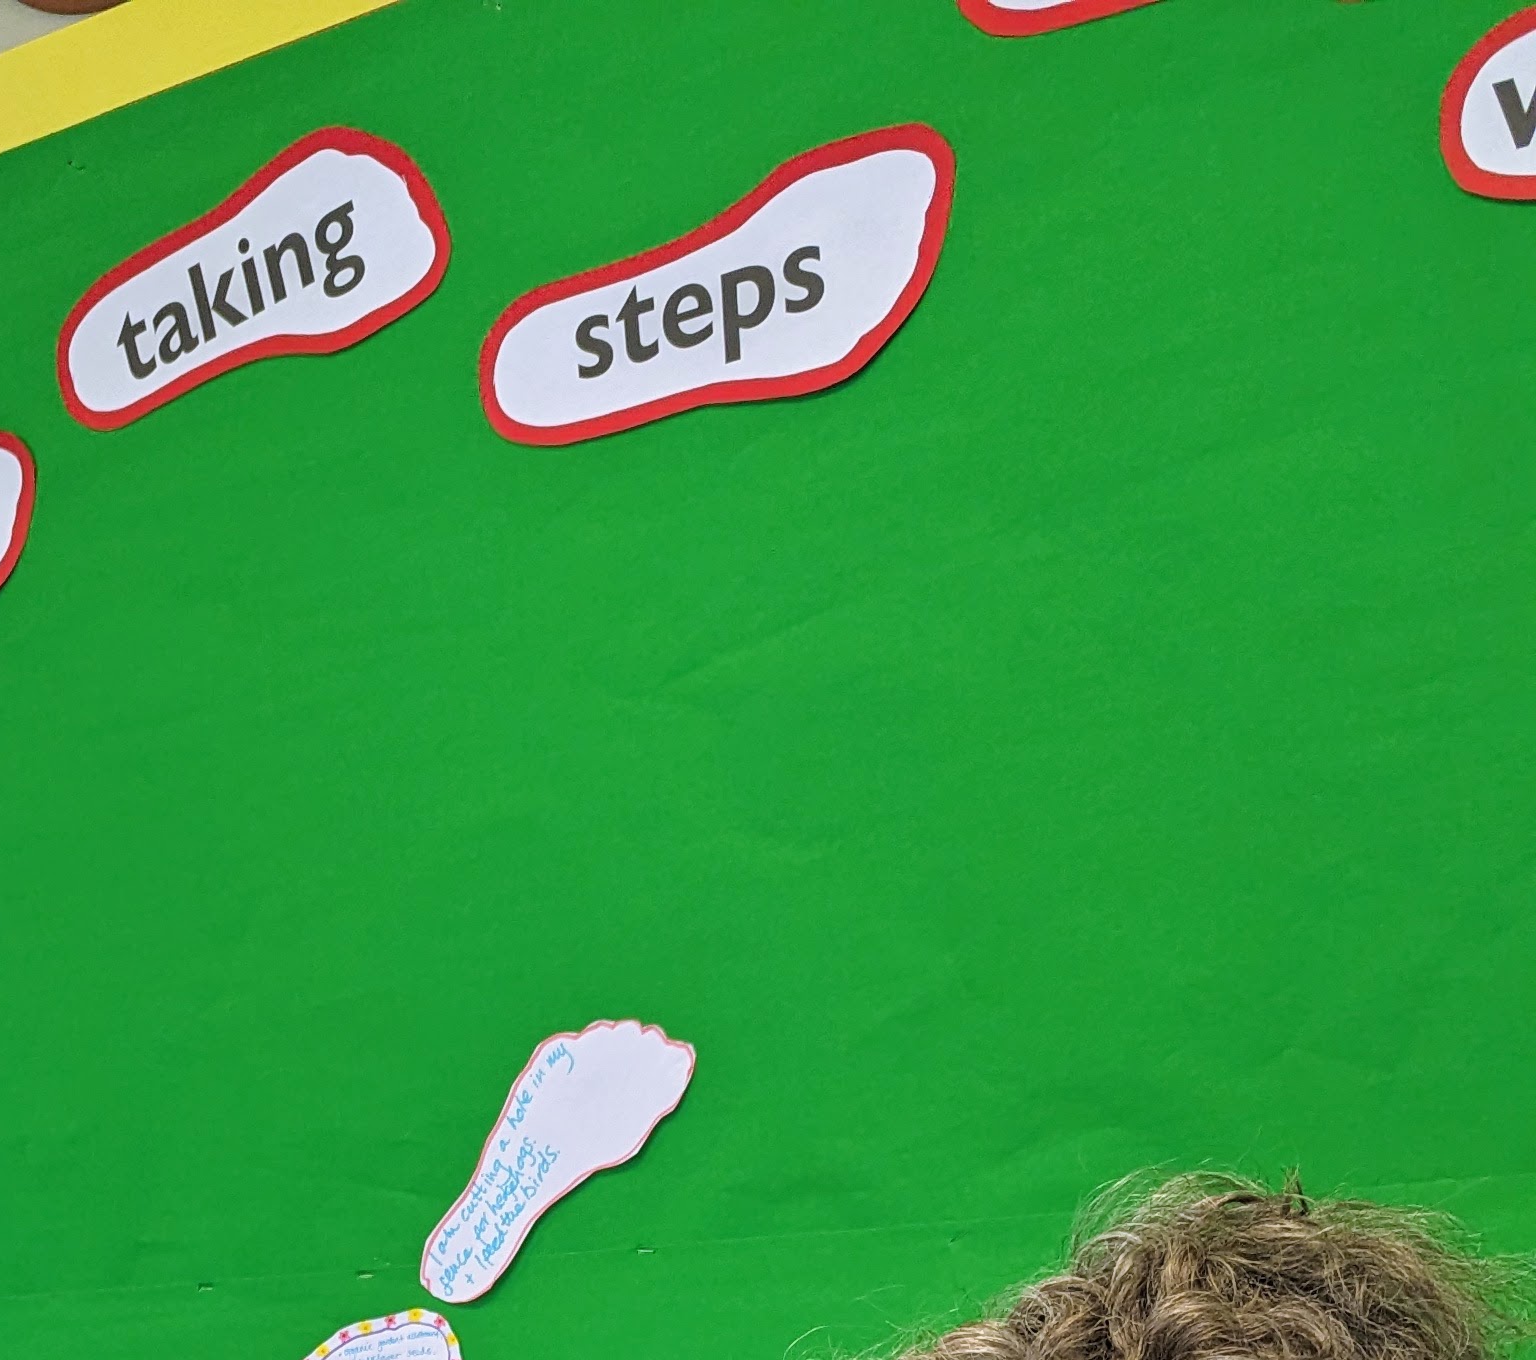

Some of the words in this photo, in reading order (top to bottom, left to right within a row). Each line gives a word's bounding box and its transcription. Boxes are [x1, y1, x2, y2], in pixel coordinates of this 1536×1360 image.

[119, 200, 367, 379] taking
[573, 245, 827, 379] steps
[438, 1224, 460, 1253] am
[460, 1158, 510, 1222] cutting
[499, 1137, 511, 1152] a
[507, 1090, 533, 1130] hole
[530, 1068, 546, 1089] in
[546, 1042, 575, 1076] my
[500, 1200, 526, 1227] the
